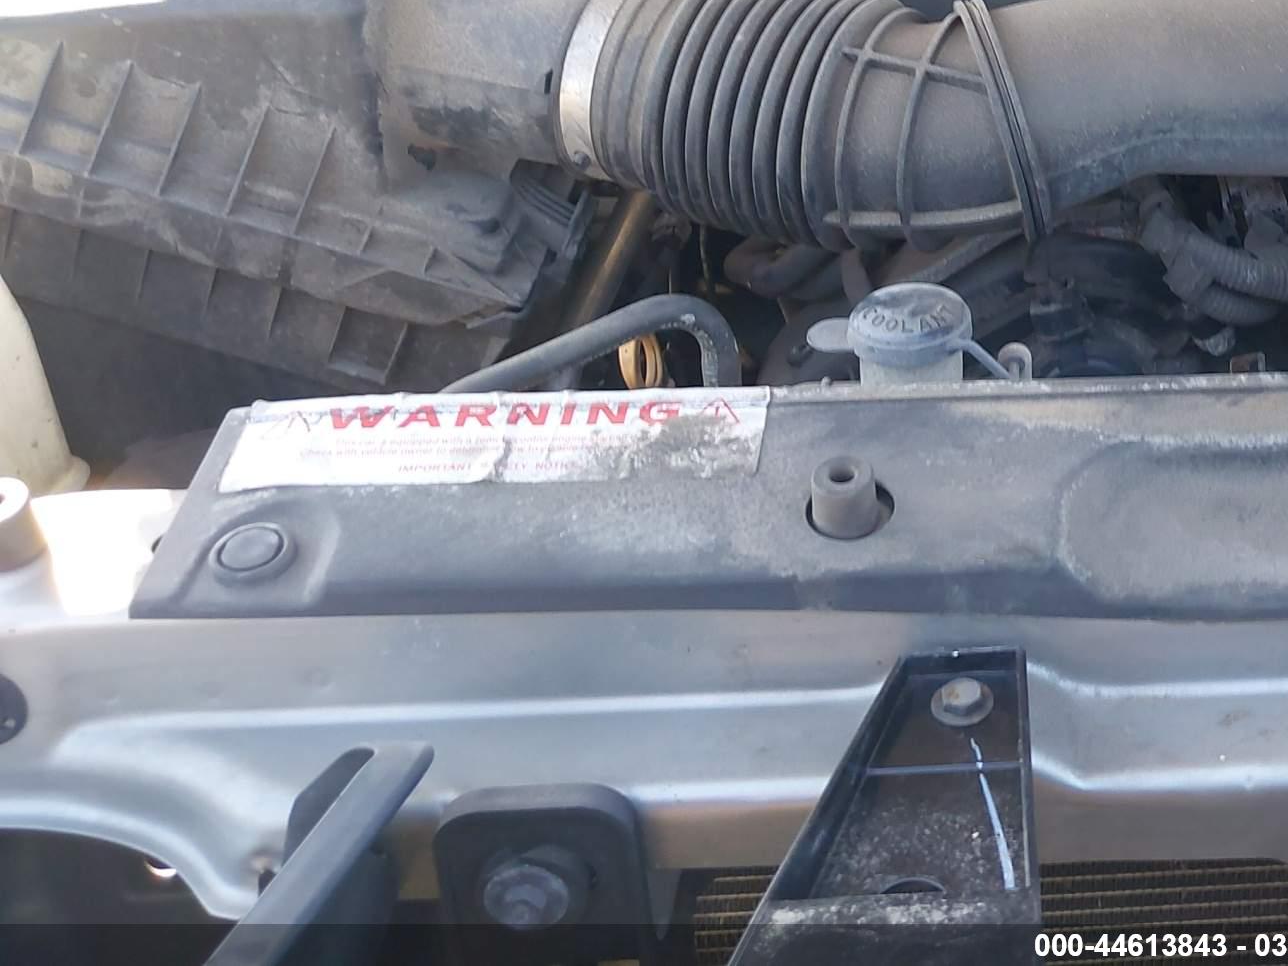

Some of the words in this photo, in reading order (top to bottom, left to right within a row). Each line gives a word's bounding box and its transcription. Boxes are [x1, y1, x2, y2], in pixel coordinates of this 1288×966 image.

[860, 304, 956, 333] COOLANT
[333, 402, 679, 430] WARNING
[398, 462, 472, 473] IMPORTANT
